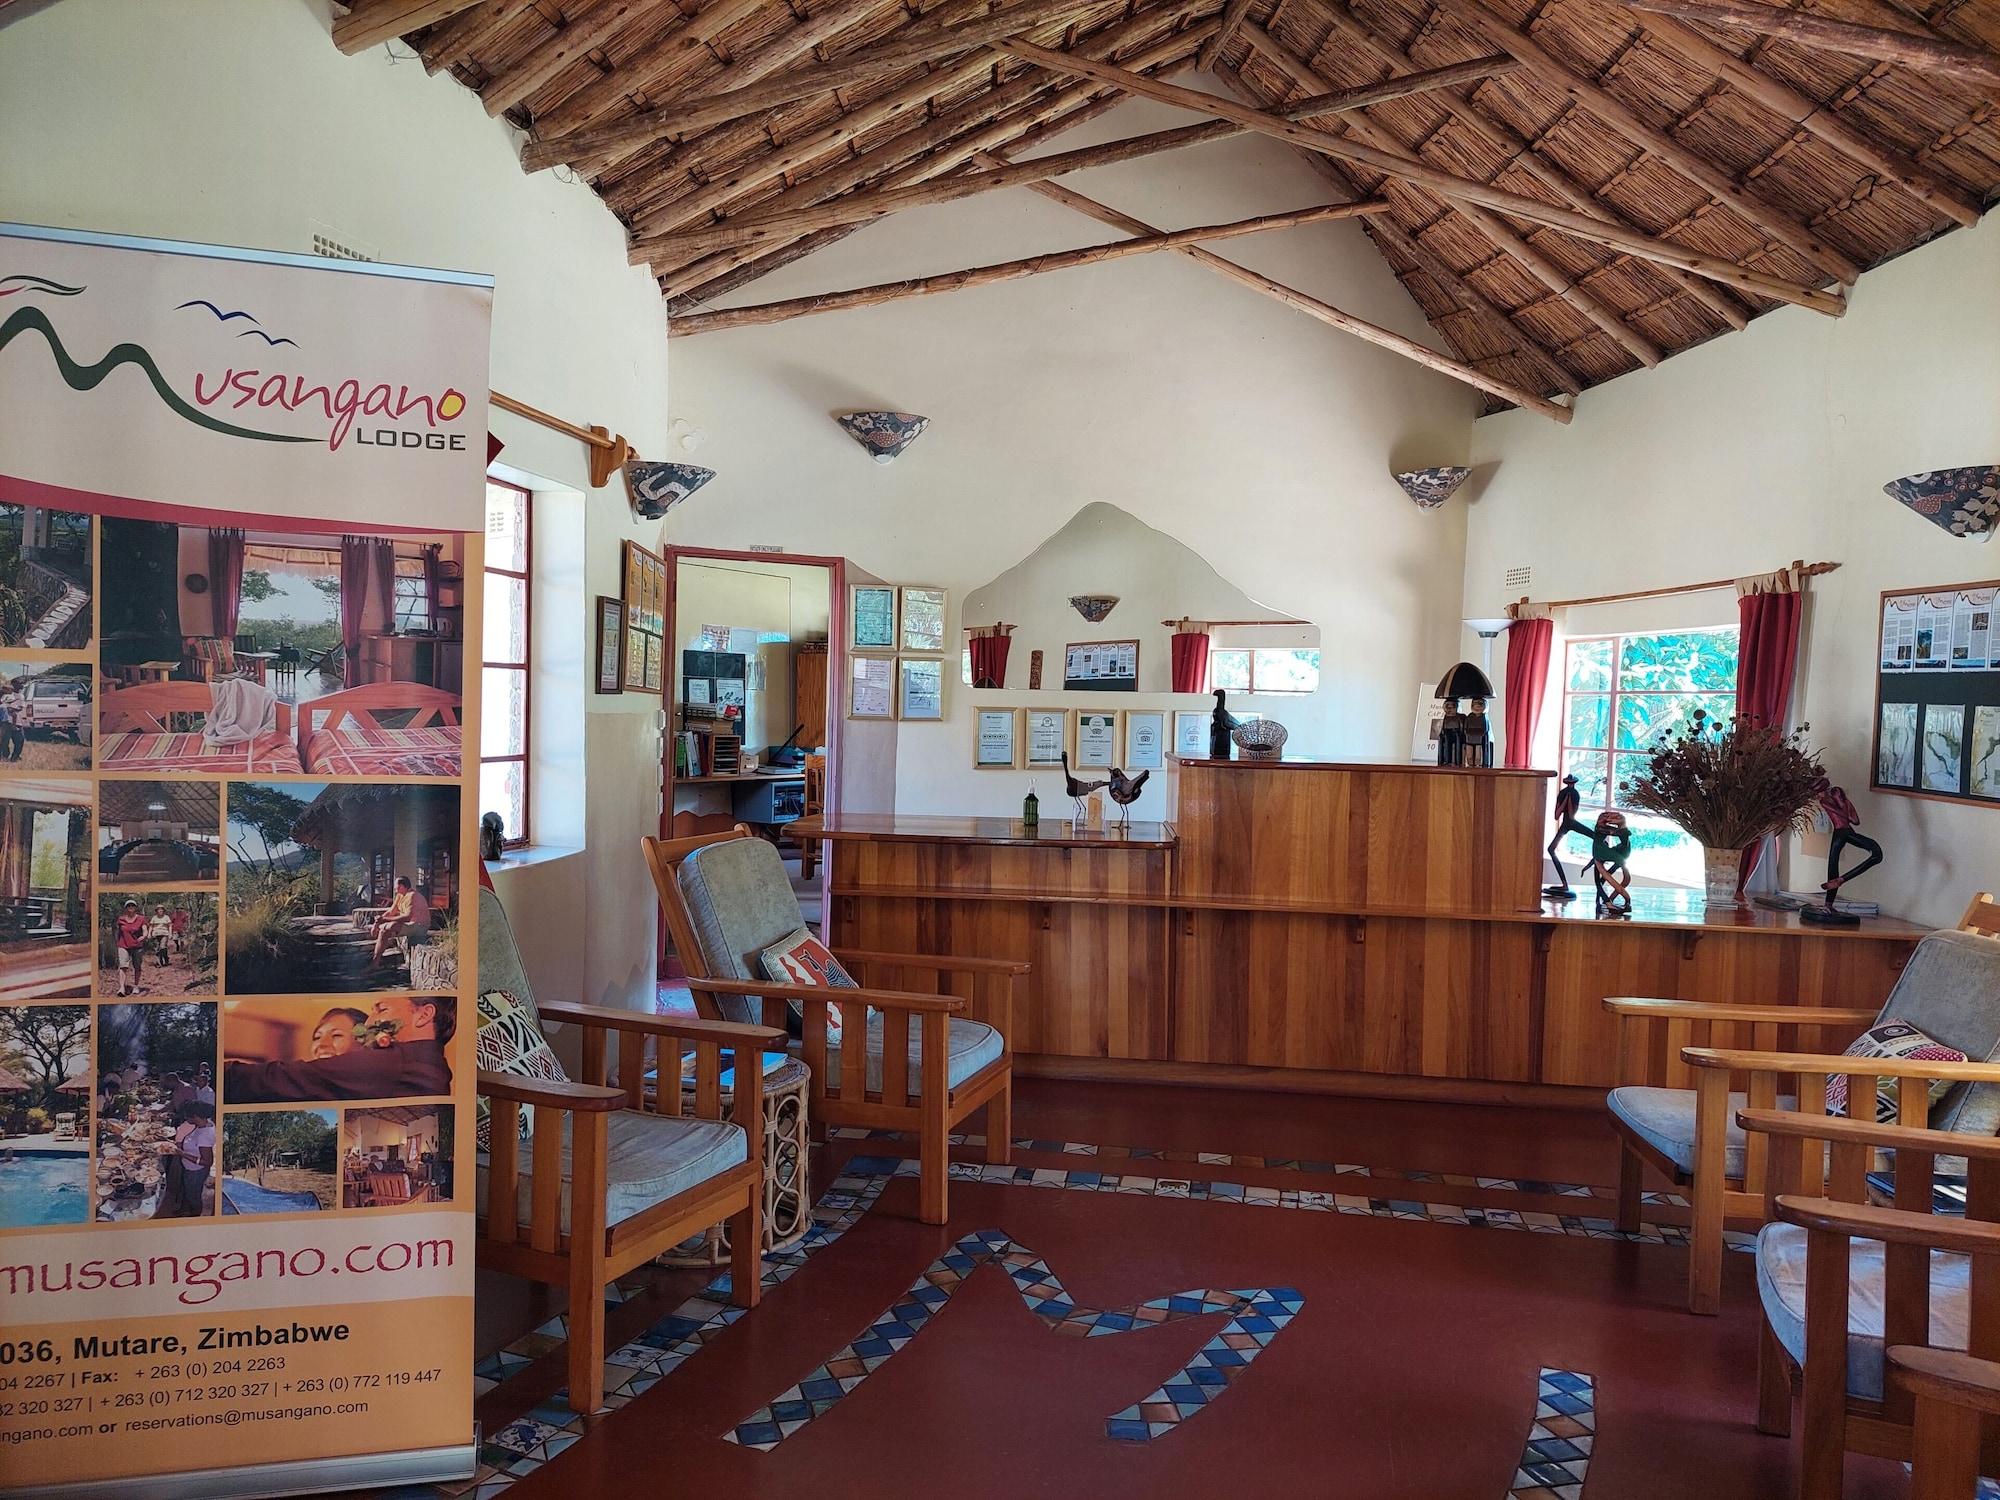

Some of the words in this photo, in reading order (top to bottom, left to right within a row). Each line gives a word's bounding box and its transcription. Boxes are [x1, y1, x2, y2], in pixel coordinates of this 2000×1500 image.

[356, 427, 467, 451] LODGE
[1426, 743, 1436, 751] 10
[0, 1339, 61, 1365] 036,
[73, 1334, 187, 1360] Mutare,
[198, 1322, 350, 1350] Zimbabwe
[18, 1400, 49, 1415] 320
[53, 1397, 84, 1413] 327
[115, 1392, 145, 1407] 263
[149, 1390, 171, 1408] (0)
[175, 1388, 204, 1402] 712
[208, 1385, 237, 1400] 320
[241, 1382, 270, 1397] 327
[296, 1378, 325, 1393] 263
[329, 1376, 349, 1393] (0)
[353, 1374, 380, 1388] 772
[385, 1371, 410, 1386] 119
[414, 1368, 442, 1383] 447
[24, 1373, 66, 1389] 2267
[81, 1371, 119, 1385] Fax:
[150, 1364, 180, 1379] 263
[186, 1362, 208, 1380] (0)
[212, 1360, 242, 1374] 204
[247, 1356, 286, 1372] 2263
[0, 1424, 93, 1445] ngano.com
[99, 1422, 118, 1434] or
[125, 1402, 369, 1431] reservations@musangano.com
